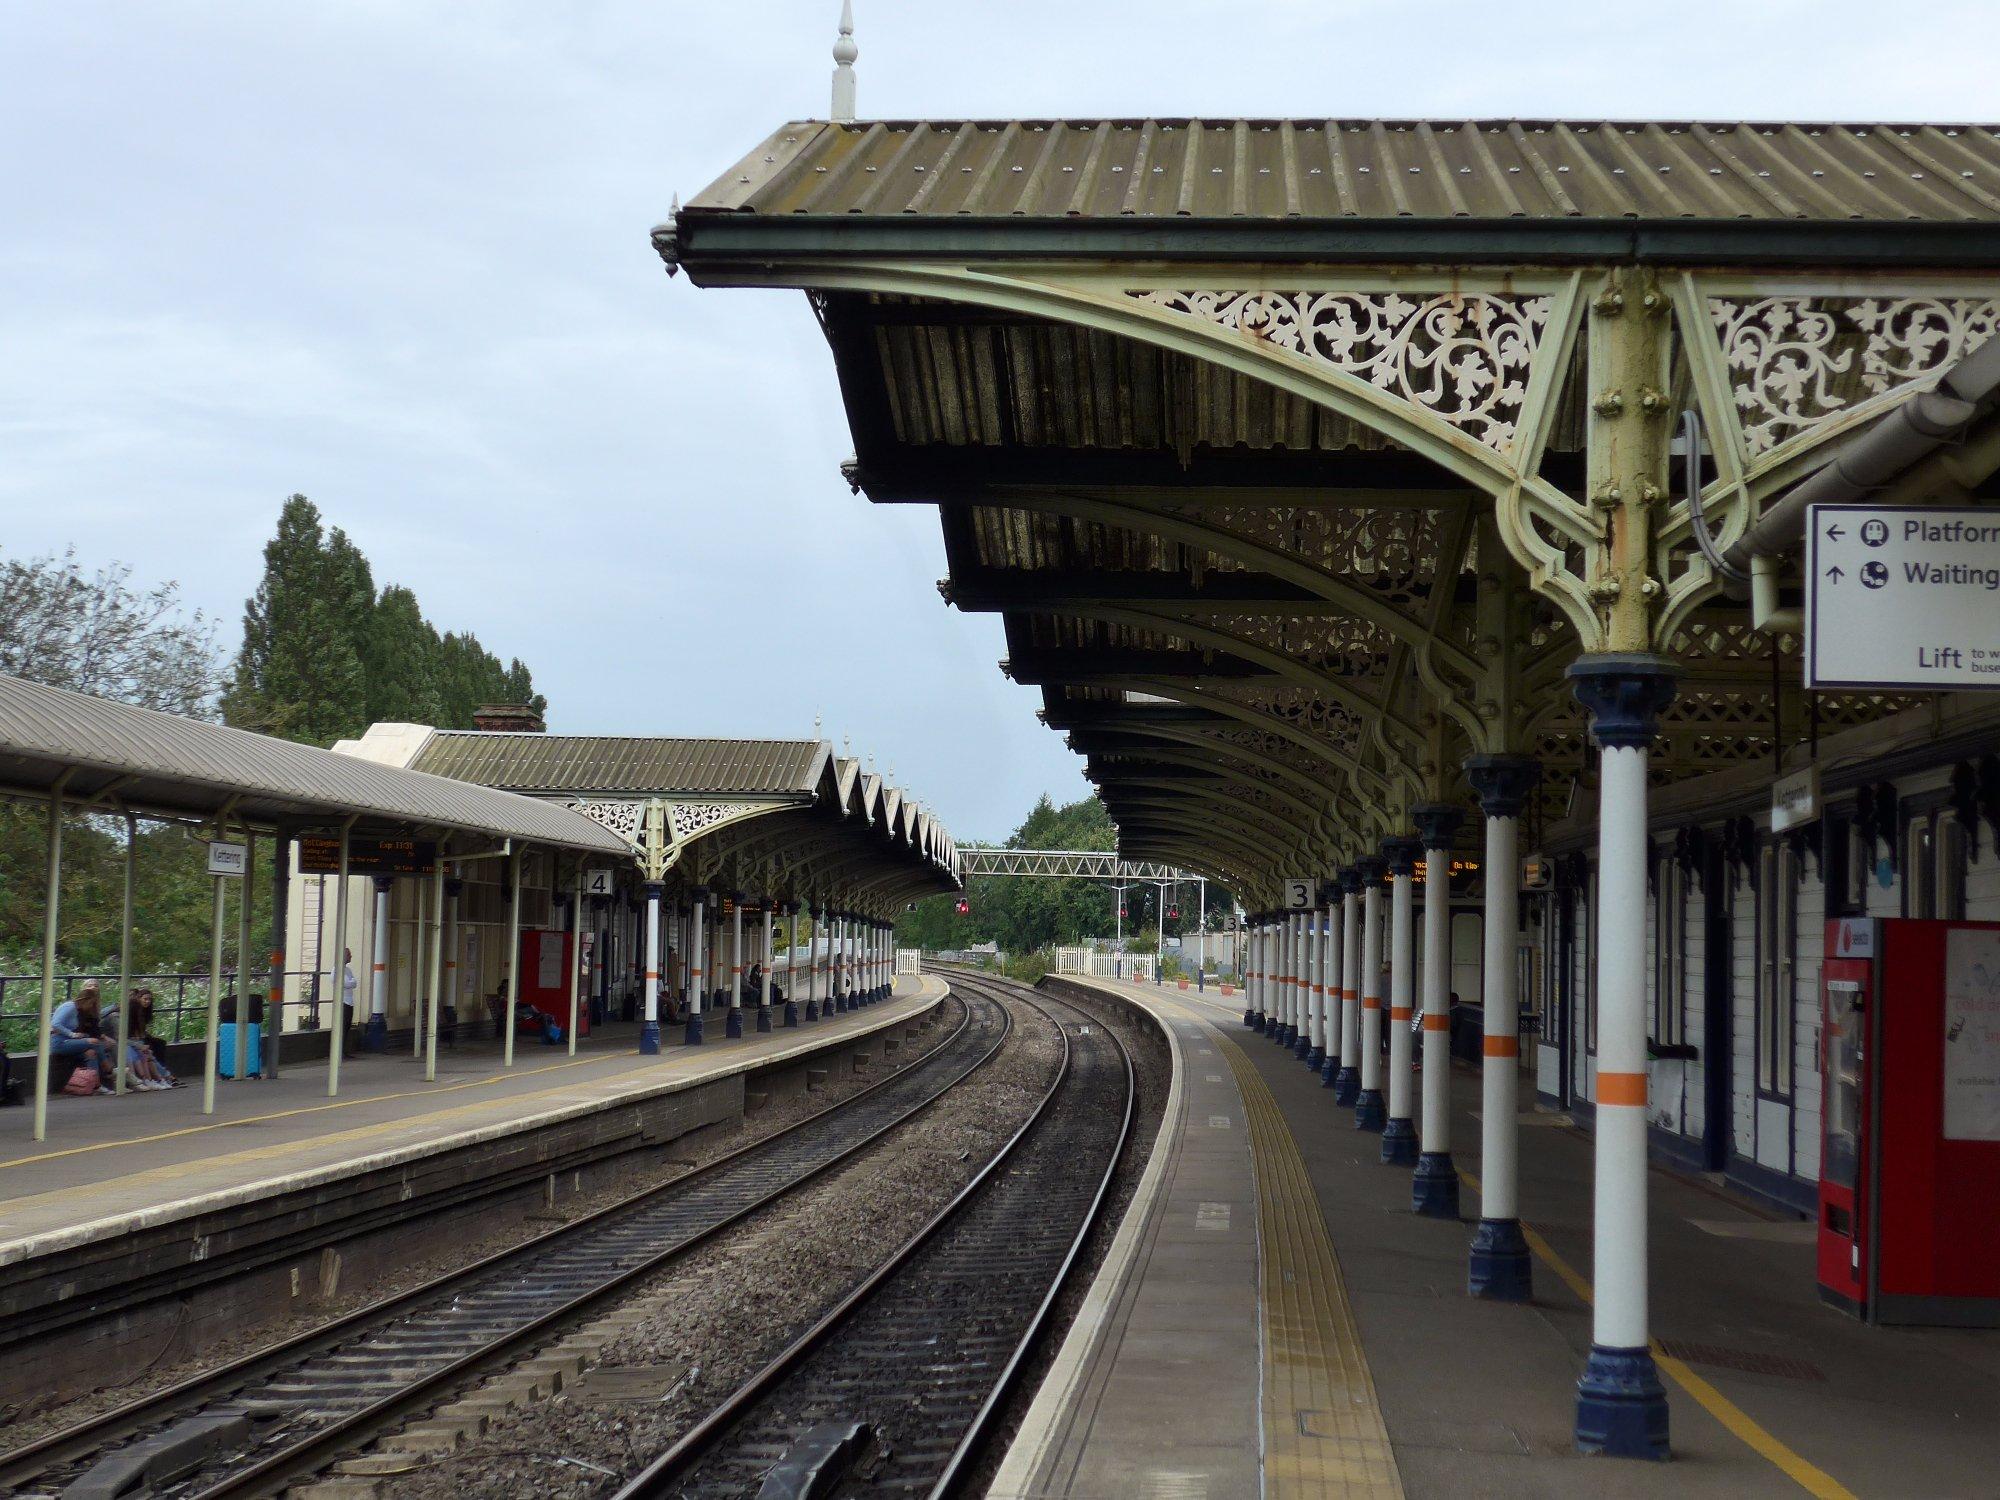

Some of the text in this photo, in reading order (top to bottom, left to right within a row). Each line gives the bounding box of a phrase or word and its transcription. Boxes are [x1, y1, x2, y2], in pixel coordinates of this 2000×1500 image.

[1904, 562, 2000, 590] Waiting
[1919, 646, 1963, 669] Lift
[1971, 649, 1985, 659] to
[214, 847, 242, 868] Kettering
[592, 874, 606, 892] 4
[1293, 885, 1308, 907] 3
[1227, 917, 1237, 930] 3
